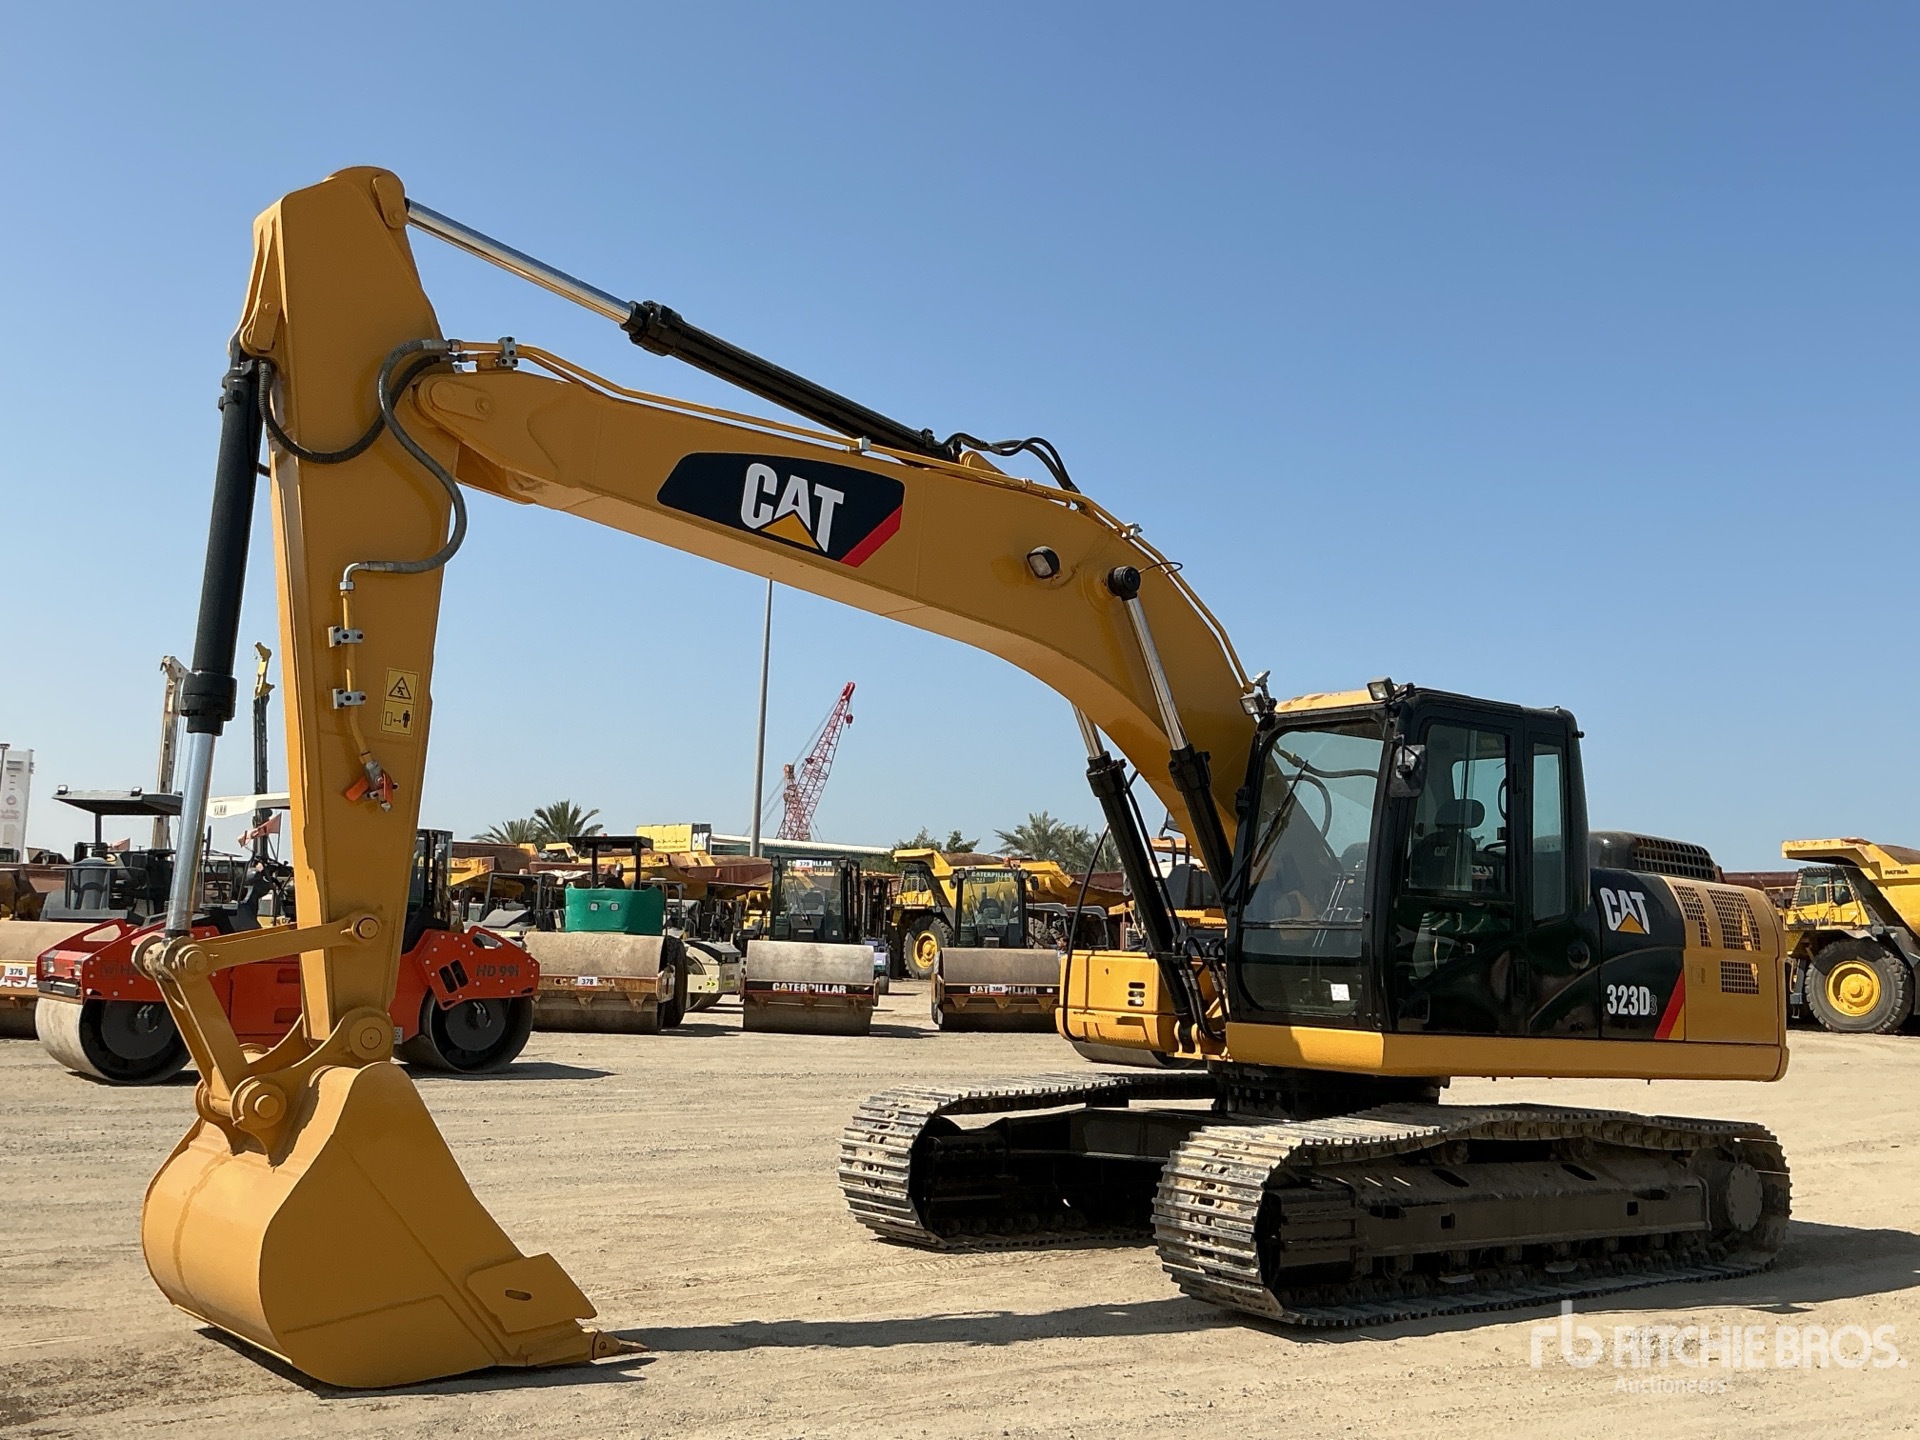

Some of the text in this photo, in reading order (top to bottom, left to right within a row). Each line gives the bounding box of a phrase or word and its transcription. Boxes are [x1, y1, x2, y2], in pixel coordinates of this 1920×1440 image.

[741, 463, 845, 553] CAT
[693, 832, 709, 850] CAT
[1600, 887, 1650, 934] CAT
[8, 967, 24, 976] 376
[476, 964, 519, 977] HD 99i
[581, 978, 594, 986] 378
[772, 982, 847, 994] CATERPILLAR
[969, 985, 1037, 995] CATILLAR
